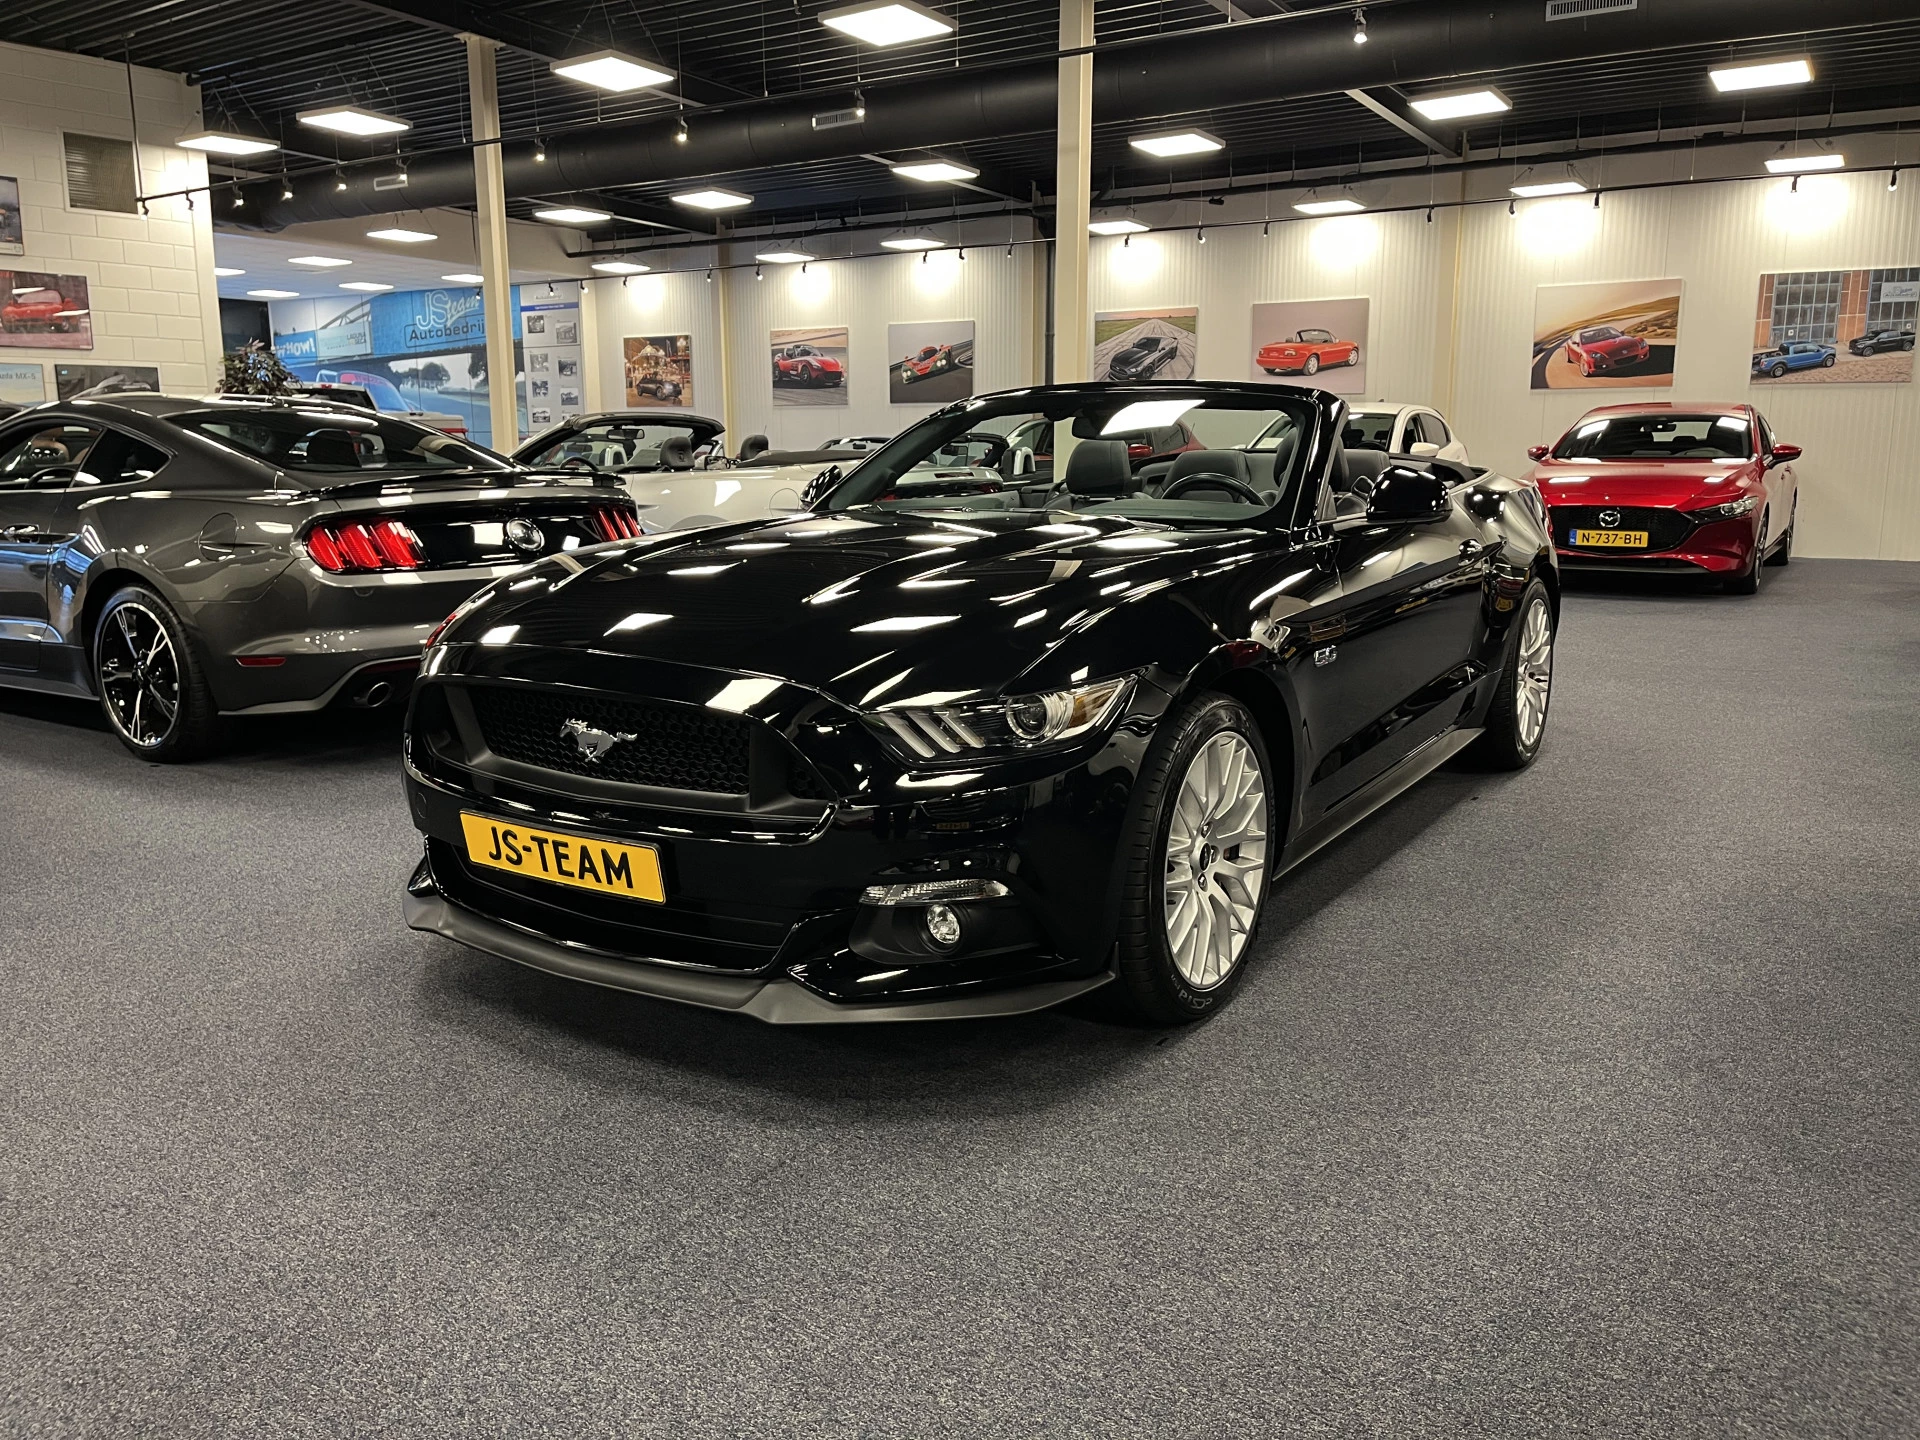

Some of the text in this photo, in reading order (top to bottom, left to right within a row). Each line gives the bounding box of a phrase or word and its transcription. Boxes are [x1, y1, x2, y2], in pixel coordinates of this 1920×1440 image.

[409, 319, 485, 342] Autobedrij
[15, 372, 36, 380] MX-5
[1582, 532, 1642, 545] N-737-BH
[489, 826, 634, 889] JS-TEAM
